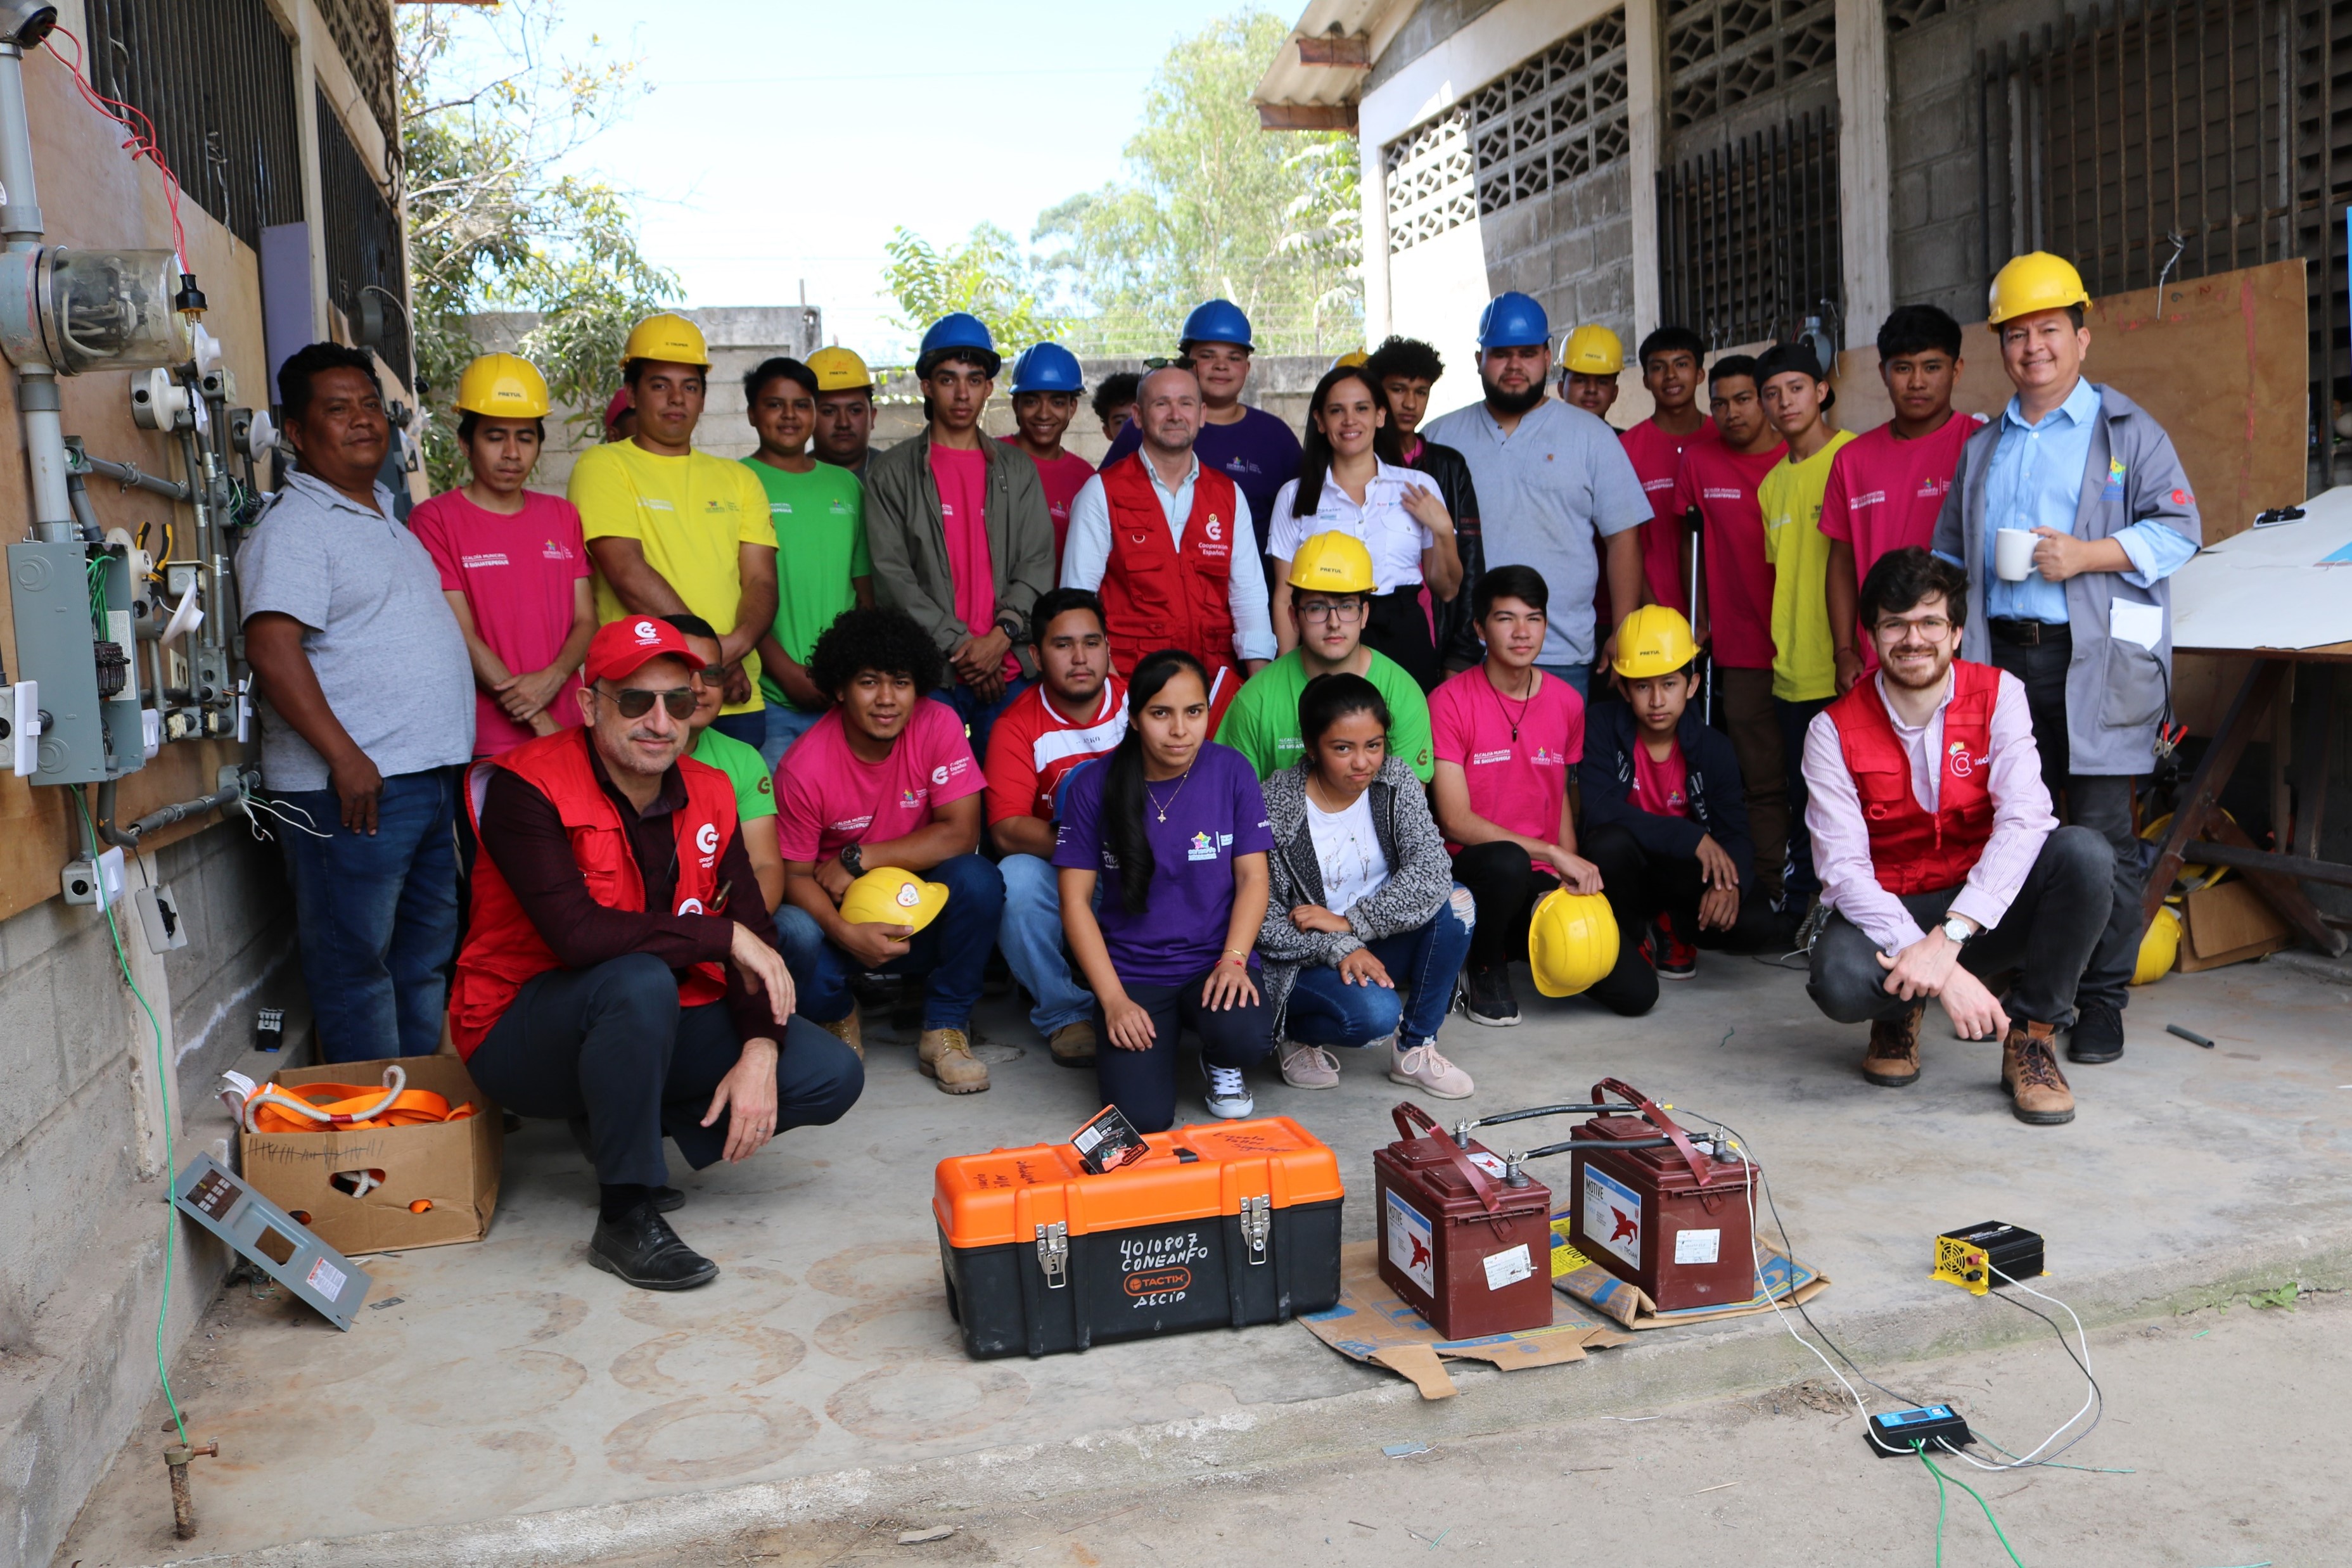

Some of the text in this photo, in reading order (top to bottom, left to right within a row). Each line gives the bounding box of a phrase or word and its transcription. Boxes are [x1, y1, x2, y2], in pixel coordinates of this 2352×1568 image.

[1586, 1178, 1604, 1200] MOTIVE
[1388, 1202, 1403, 1226] MOTIVE
[1120, 1233, 1198, 1259] 4010807
[1623, 1245, 1638, 1259] TROJAN
[1122, 1247, 1208, 1272] CONEANFO
[1142, 1274, 1184, 1287] TACTIX
[1420, 1273, 1432, 1288] TROJAN
